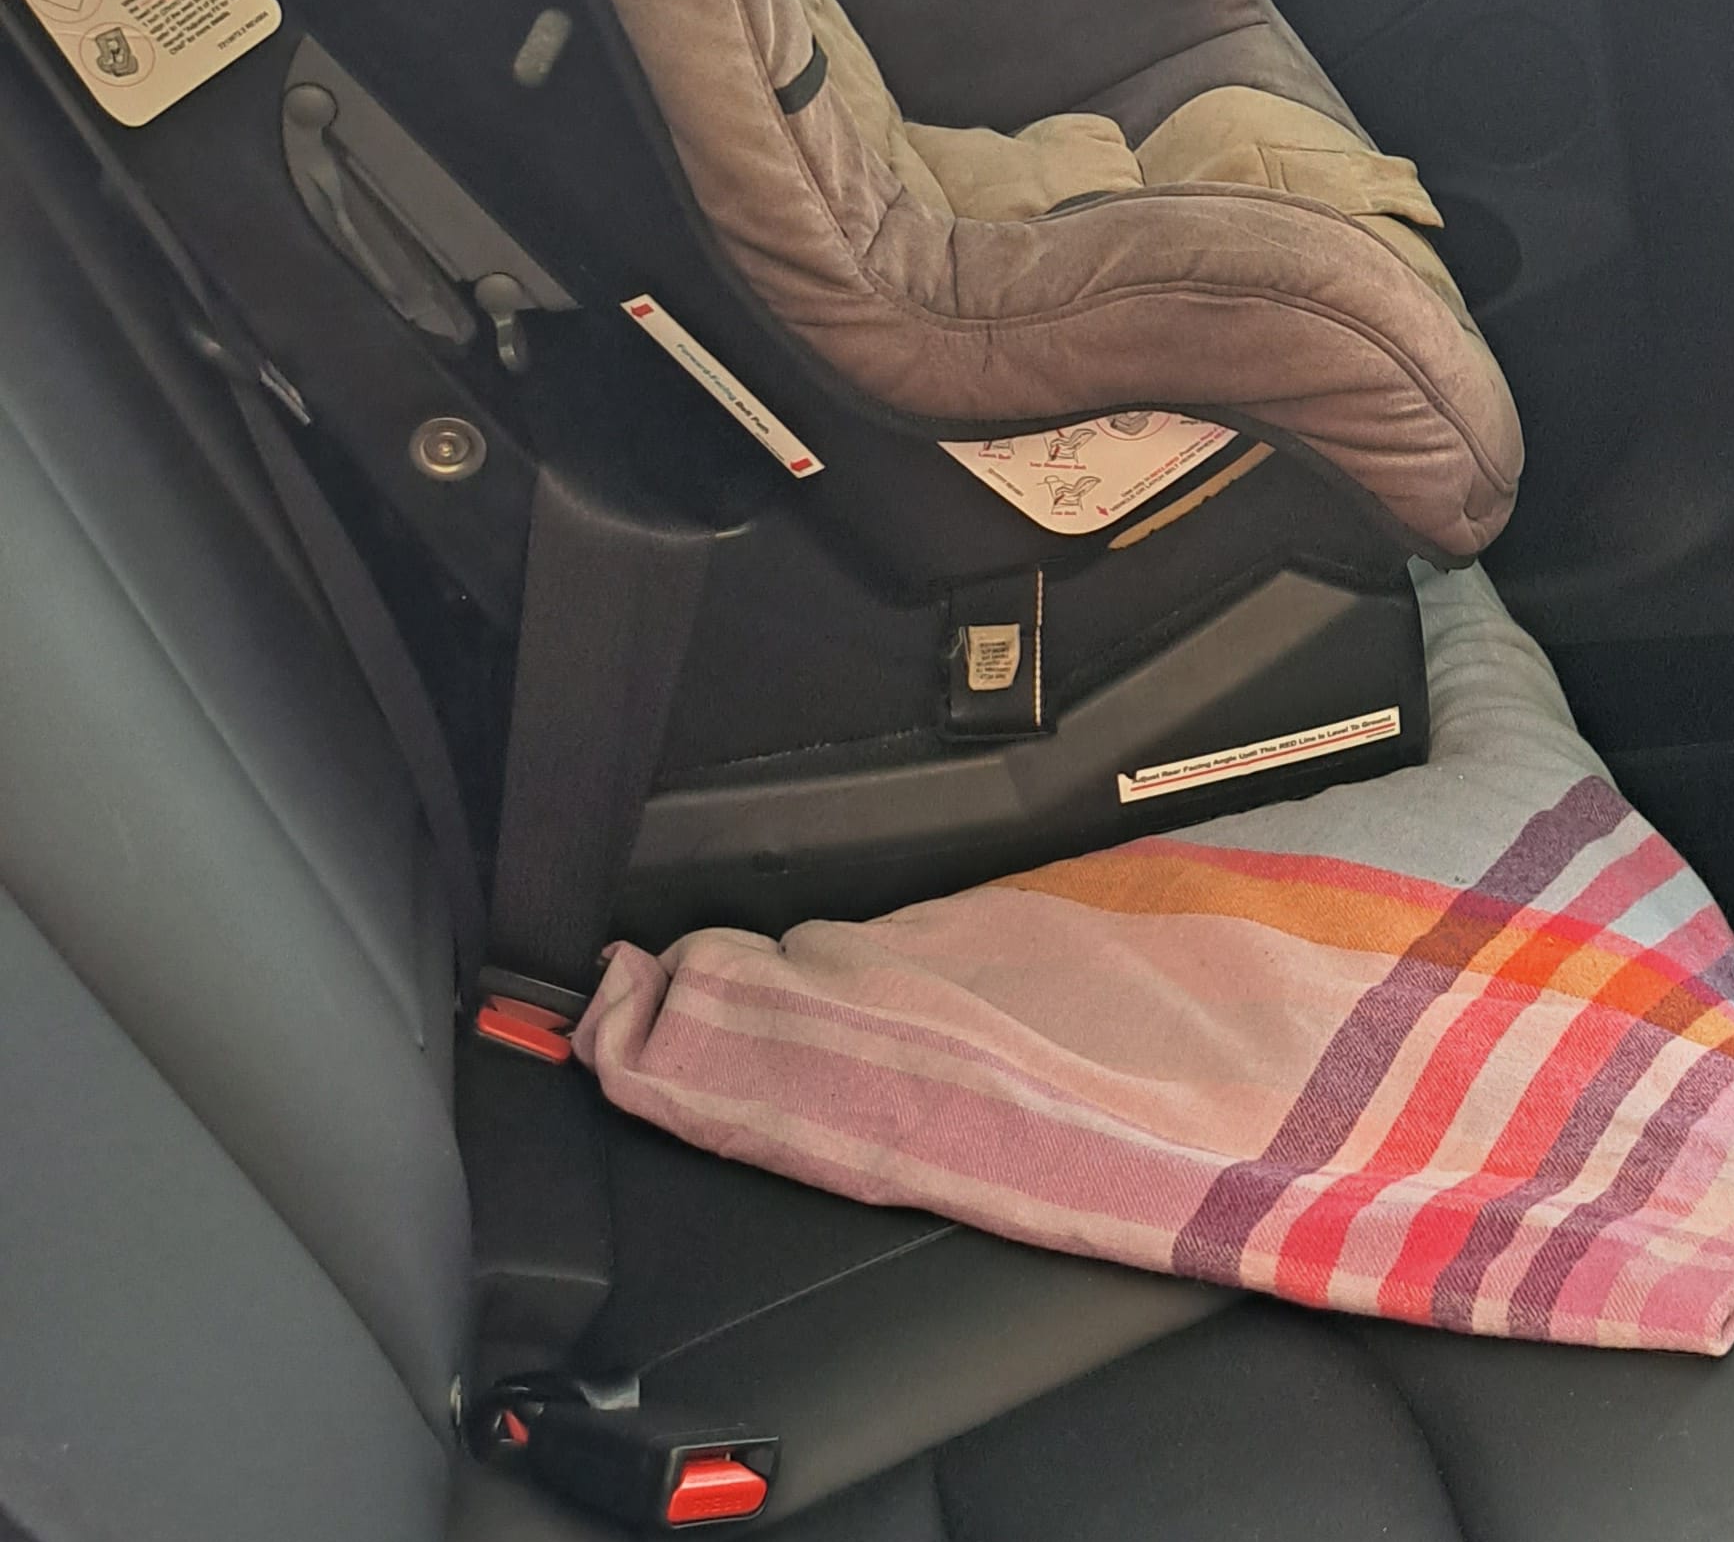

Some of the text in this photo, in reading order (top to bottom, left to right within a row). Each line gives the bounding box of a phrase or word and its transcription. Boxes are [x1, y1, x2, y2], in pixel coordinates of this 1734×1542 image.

[675, 341, 737, 402] Forward-Facing
[1161, 767, 1181, 777] Rear
[1182, 760, 1211, 773] Facing
[1212, 754, 1237, 766] Angle
[1259, 744, 1276, 754] This
[1278, 739, 1297, 749] RED
[1298, 734, 1316, 744] Line
[1326, 726, 1348, 737] Level
[1361, 714, 1392, 728] Ground
